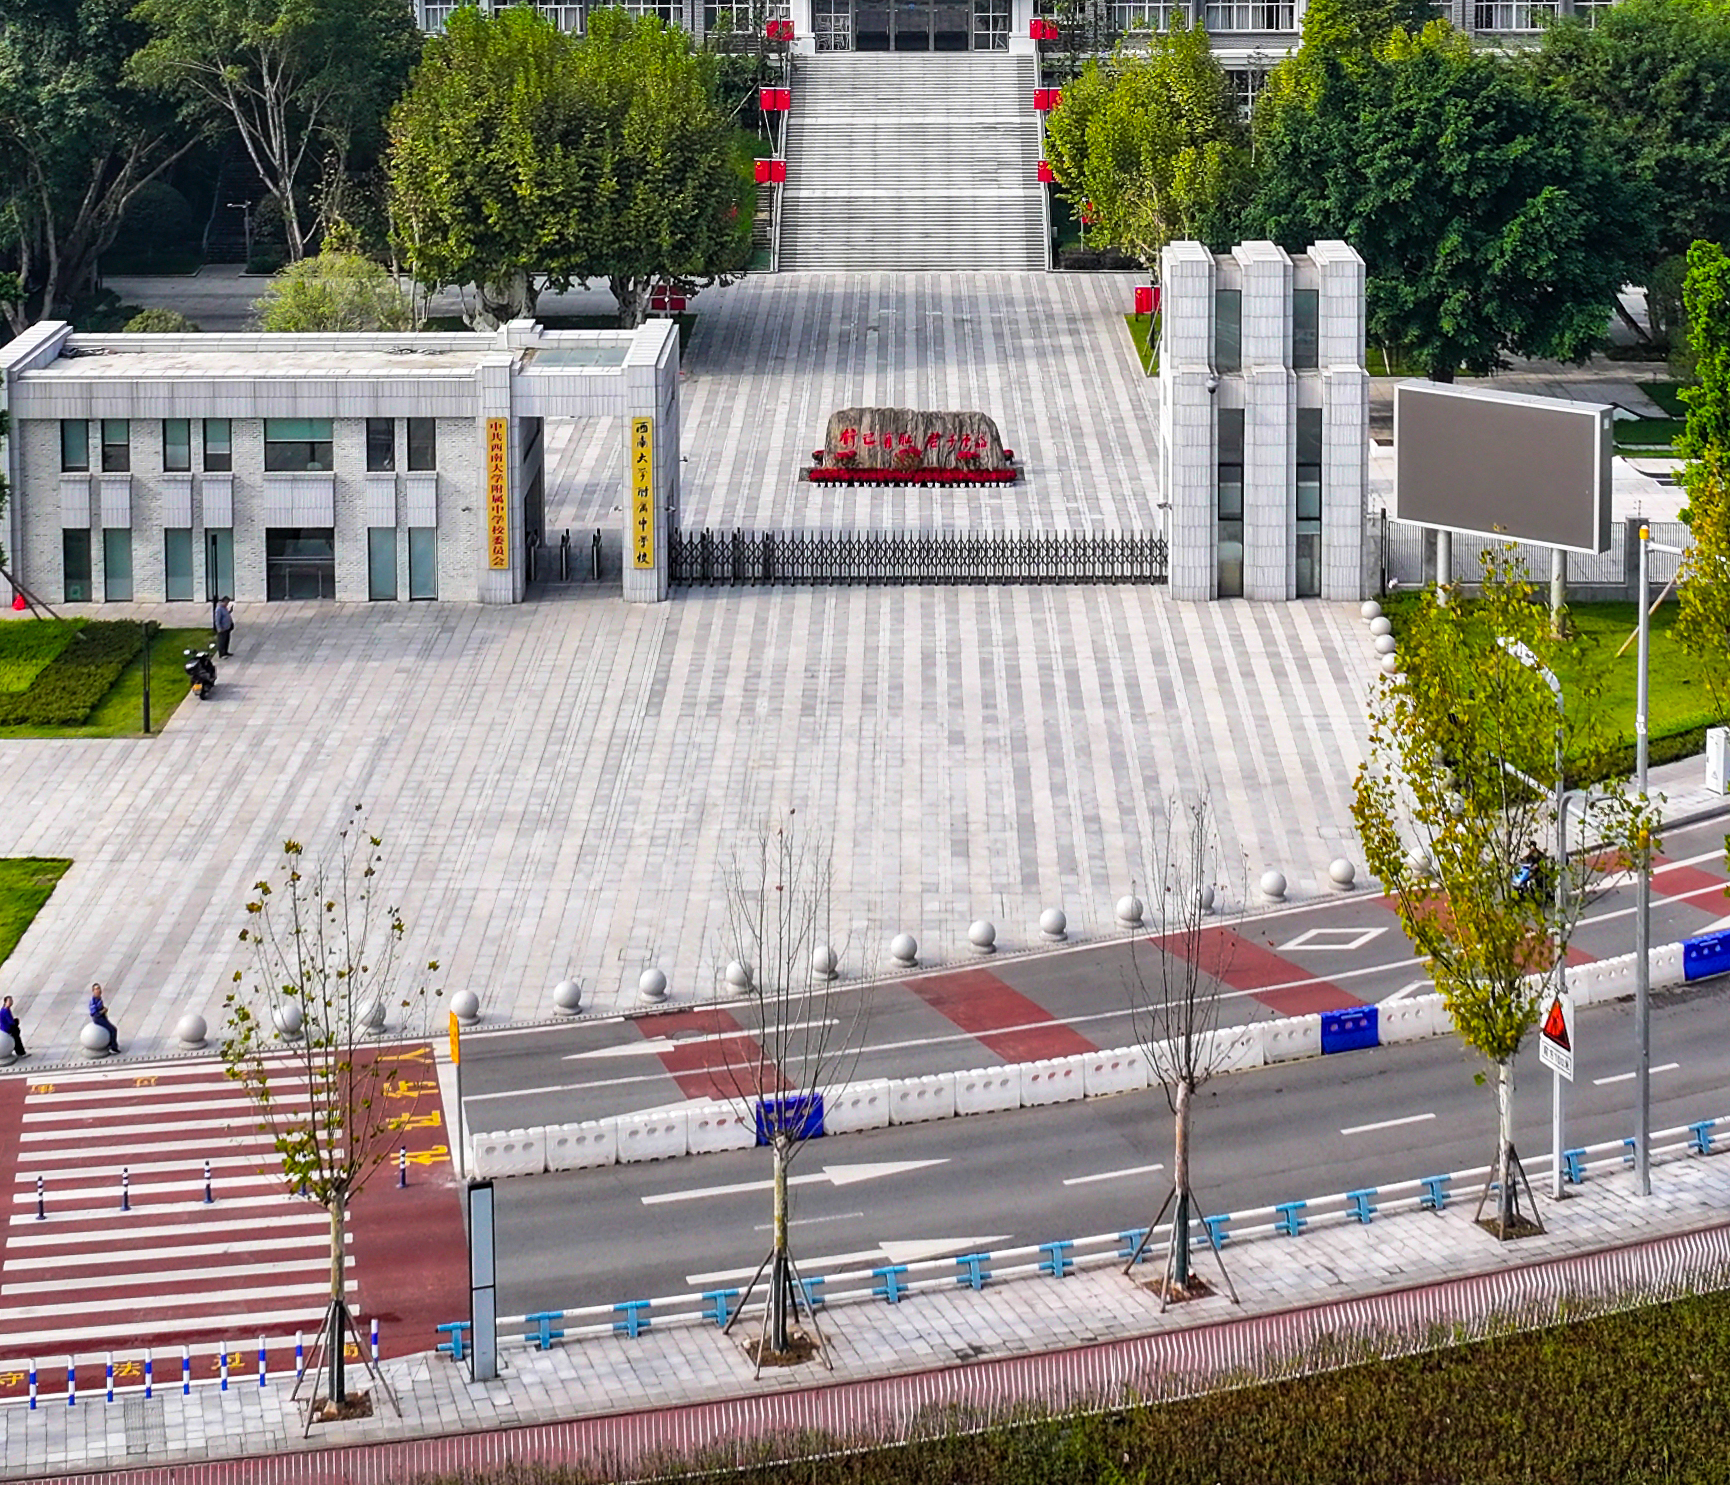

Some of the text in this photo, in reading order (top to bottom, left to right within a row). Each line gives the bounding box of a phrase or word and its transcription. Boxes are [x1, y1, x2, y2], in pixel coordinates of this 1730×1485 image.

[489, 422, 507, 566] 中共西南大学附属中学校委员会
[635, 422, 650, 565] 西南大学附属中学校
